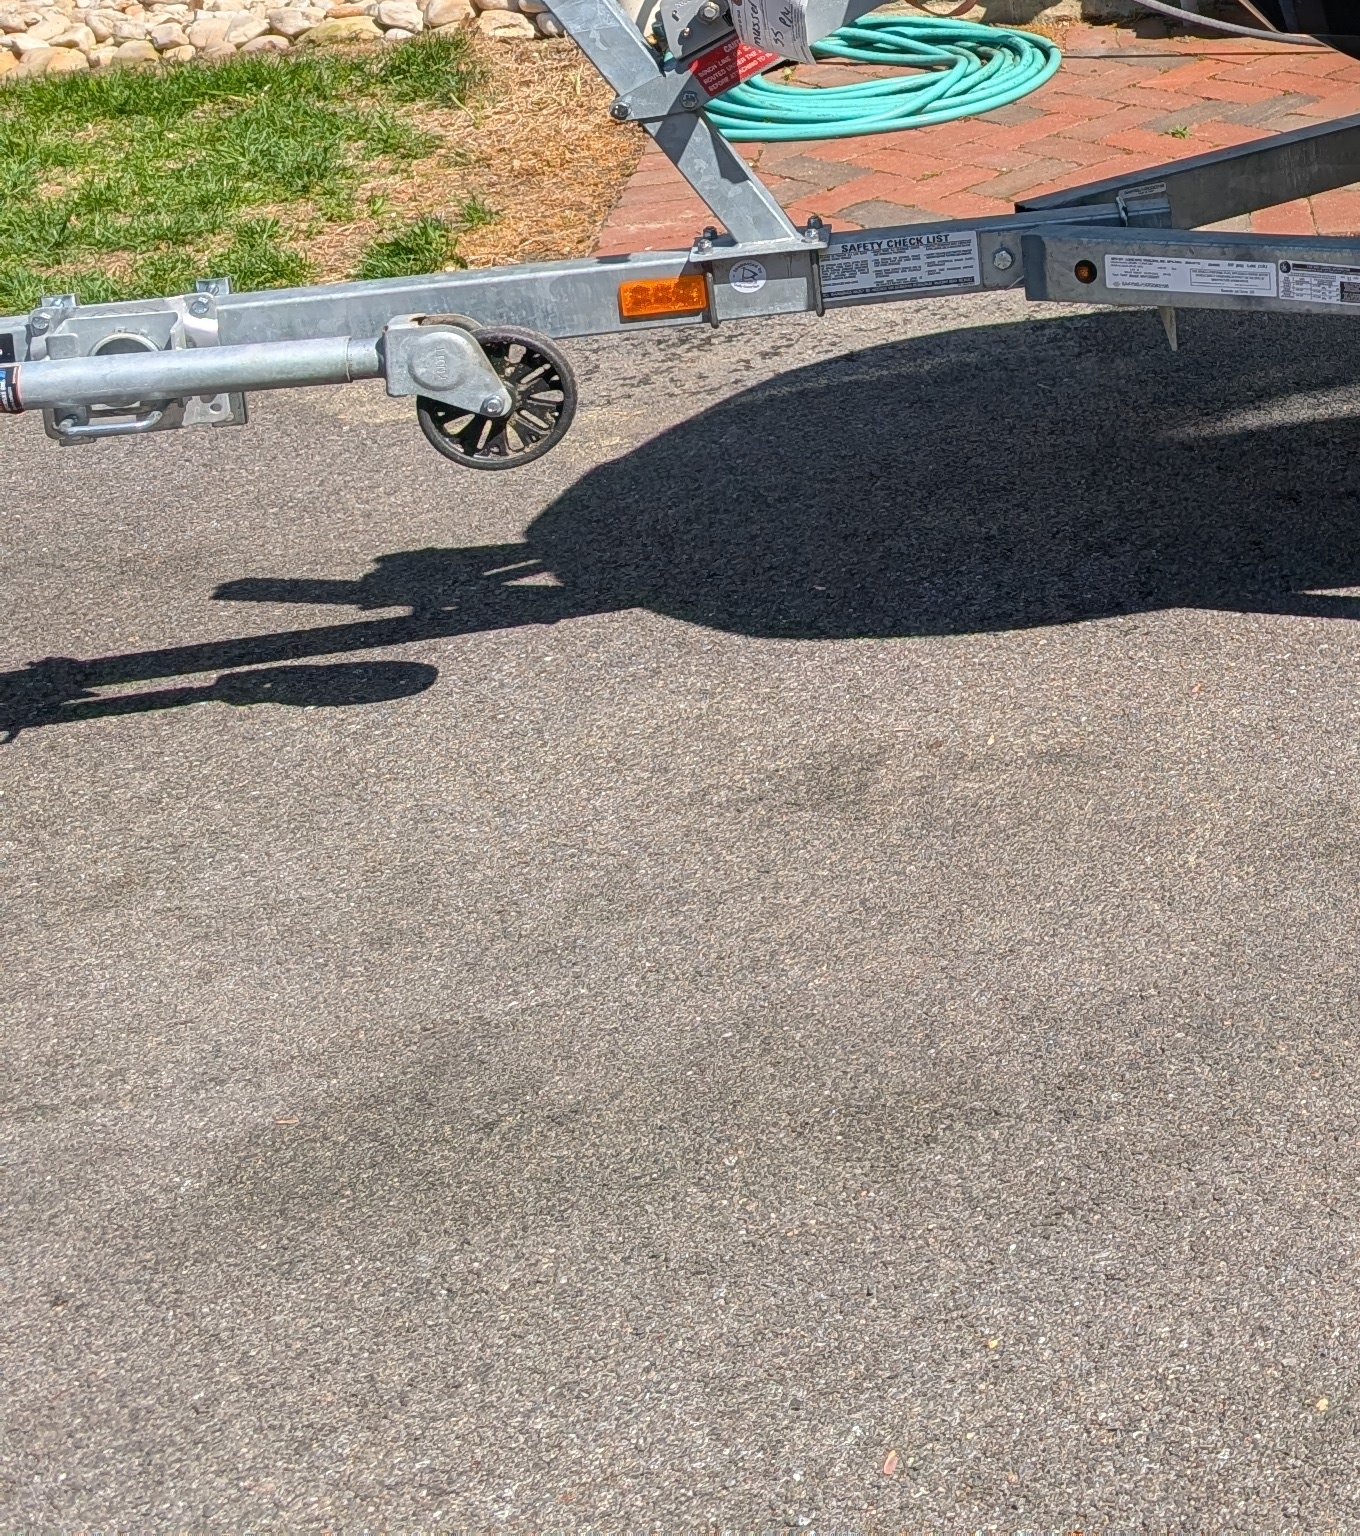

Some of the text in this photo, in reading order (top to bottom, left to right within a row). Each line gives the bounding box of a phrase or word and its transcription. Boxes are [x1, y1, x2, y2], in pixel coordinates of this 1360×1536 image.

[723, 38, 742, 52] CAUT
[840, 234, 950, 253] SAFETY CHECK LIST
